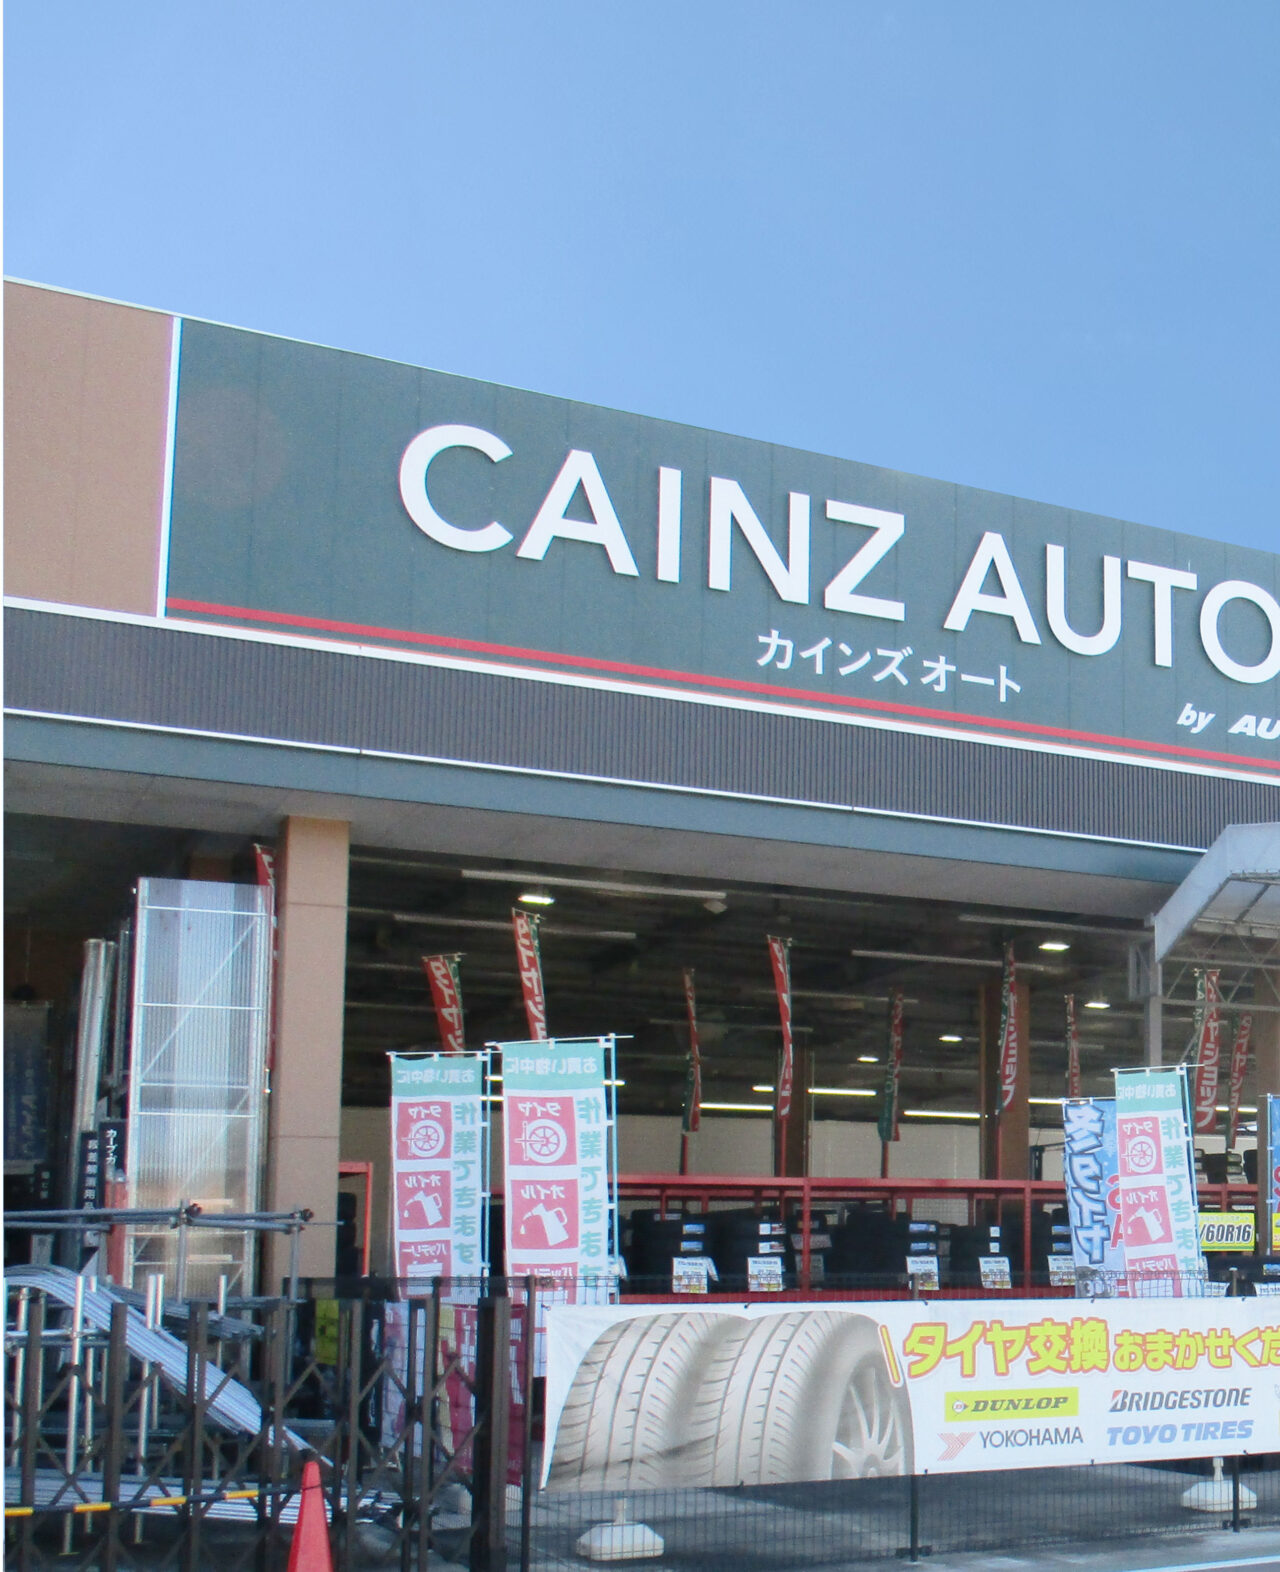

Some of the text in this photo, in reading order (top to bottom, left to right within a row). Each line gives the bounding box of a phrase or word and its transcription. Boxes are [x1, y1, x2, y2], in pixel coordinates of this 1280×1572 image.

[399, 424, 905, 621] CAINZ
[756, 629, 1022, 702] カインズ オート
[1176, 703, 1216, 734] by
[1200, 1224, 1253, 1243] /60R16
[970, 1396, 1069, 1413] DUNLOP
[1109, 1388, 1252, 1413] BRIDGESTONE
[979, 1426, 1084, 1448] YOKOHAMA
[1107, 1419, 1254, 1446] TOYO TIRES
